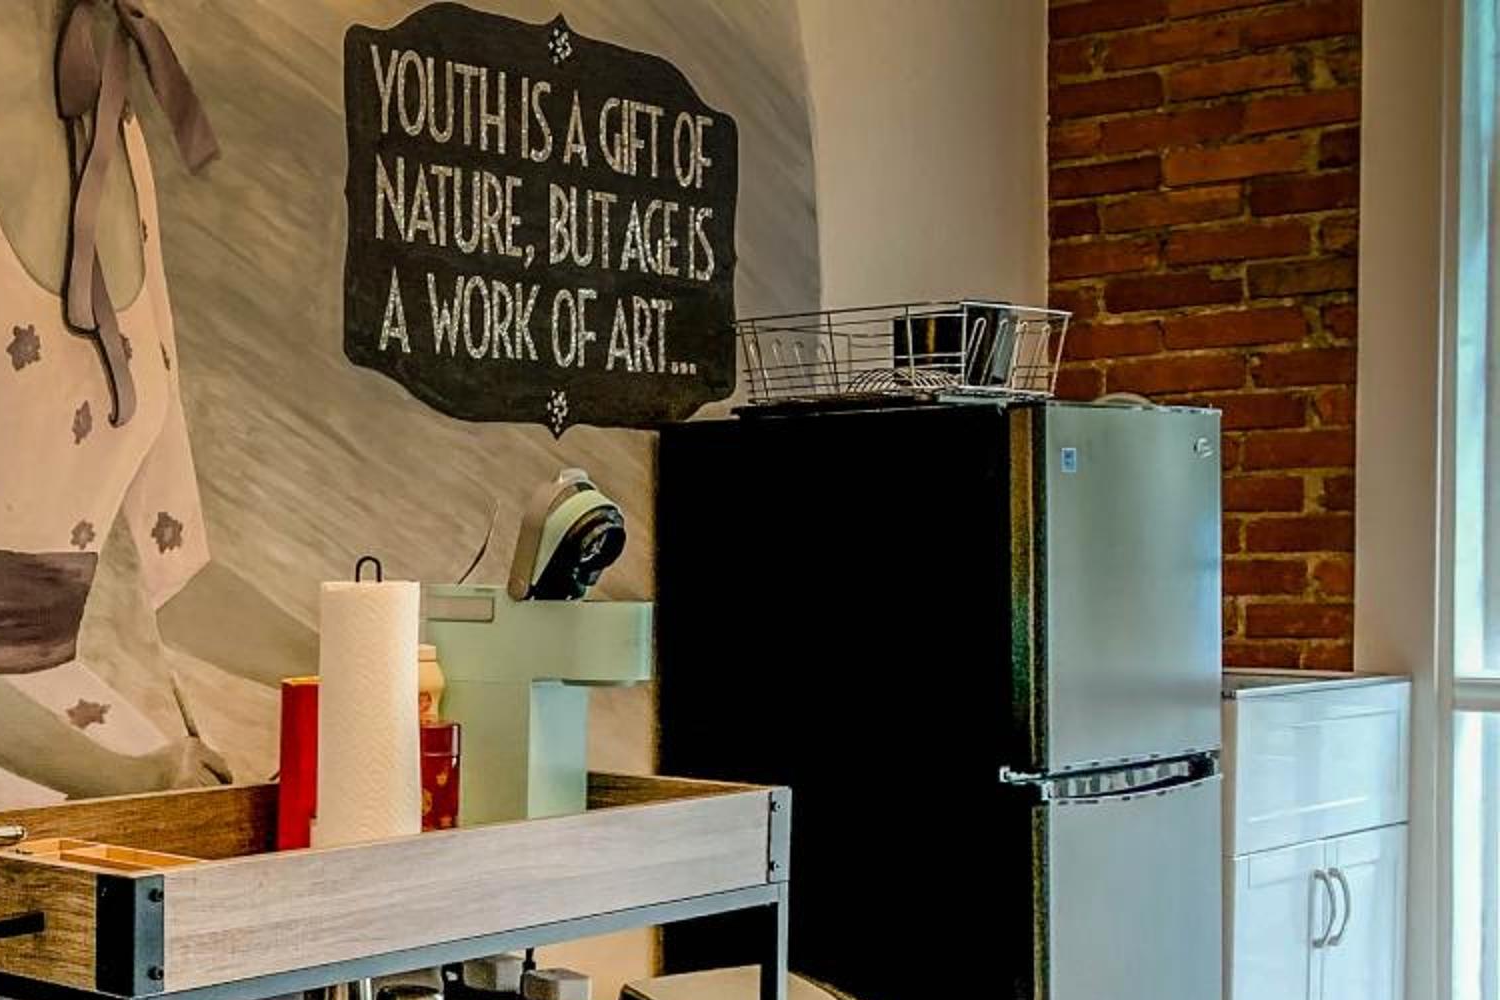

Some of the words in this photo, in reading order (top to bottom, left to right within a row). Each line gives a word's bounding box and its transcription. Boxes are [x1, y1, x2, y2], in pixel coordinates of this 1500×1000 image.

[371, 44, 506, 155] YOUTH
[521, 77, 553, 163] IS
[563, 90, 589, 168] A
[600, 97, 664, 178] GIFT
[673, 112, 713, 189] OF
[375, 154, 535, 268] NATURE,
[549, 183, 617, 269] BUT
[620, 199, 679, 277] AGE
[688, 205, 715, 281] IS
[379, 265, 411, 353] A
[426, 272, 541, 361] WORK
[551, 288, 597, 369] OF
[606, 296, 697, 375] ART...
